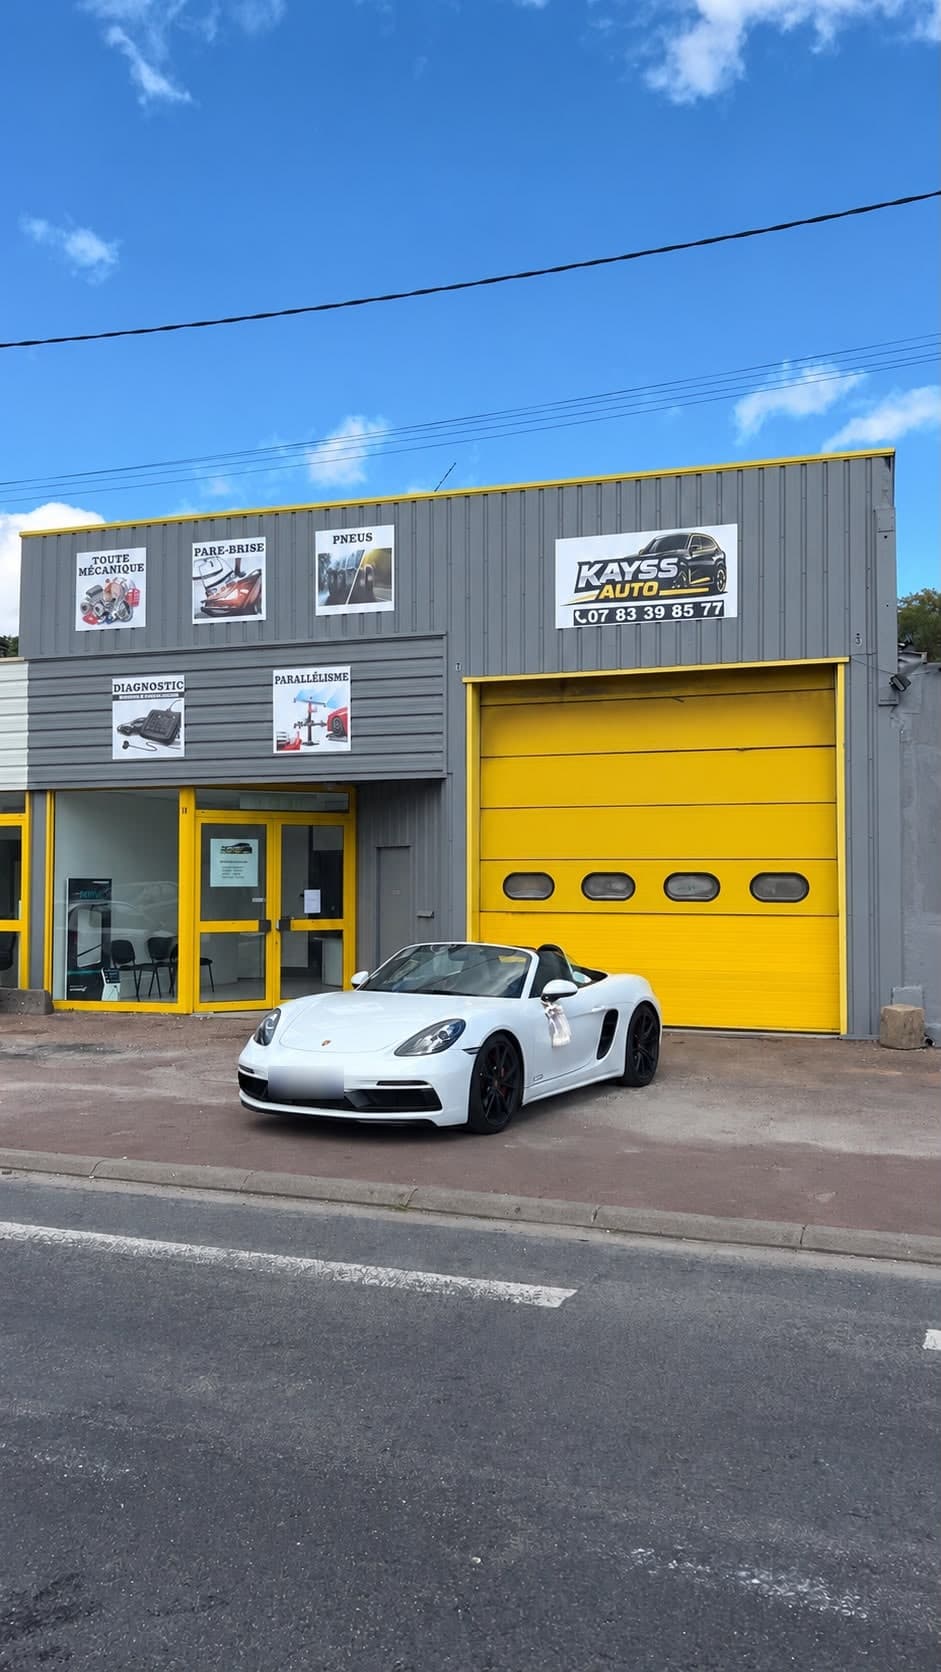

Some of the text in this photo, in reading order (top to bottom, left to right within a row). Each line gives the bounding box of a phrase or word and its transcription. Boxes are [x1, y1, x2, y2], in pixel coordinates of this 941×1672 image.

[333, 532, 373, 545] PNEUS
[194, 543, 265, 557] PARE-BRISE
[92, 554, 130, 565] TOUTE
[78, 563, 145, 577] MÉCANIQUE
[577, 558, 679, 588] KAYSS
[600, 581, 659, 599] AUTO
[587, 601, 724, 623] 07 83 39 85 77
[274, 671, 349, 685] PARALLÉLISME
[113, 681, 184, 693] DIAGNOSTIC
